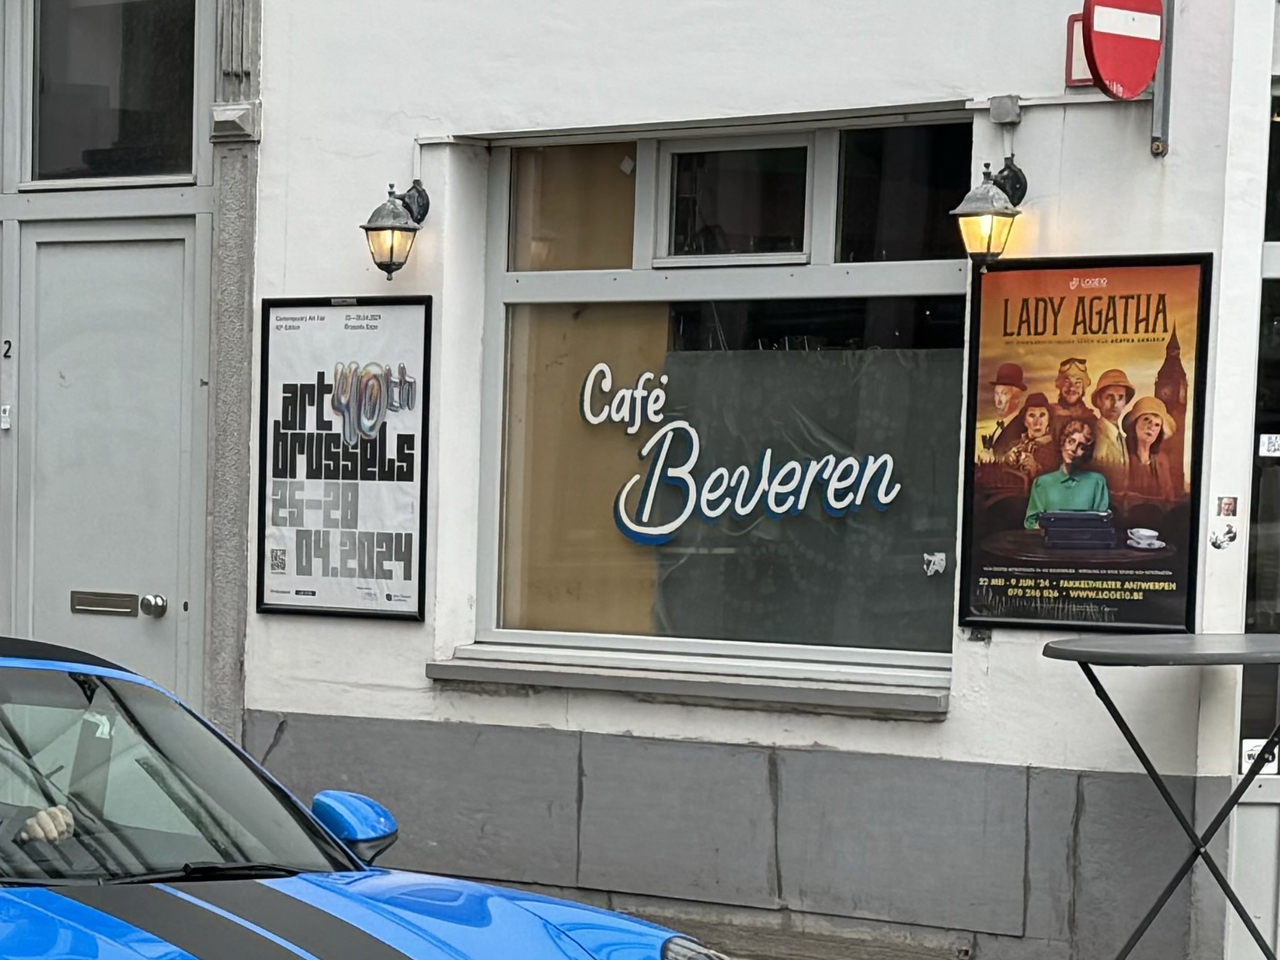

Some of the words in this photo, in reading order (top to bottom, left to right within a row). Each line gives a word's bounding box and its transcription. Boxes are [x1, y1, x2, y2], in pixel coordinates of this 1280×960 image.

[1003, 296, 1066, 337] LADY
[1072, 294, 1169, 335] AGATHA
[3, 340, 12, 359] 2
[281, 371, 334, 431] art
[582, 361, 669, 435] Café
[272, 420, 416, 482] brussels
[617, 419, 902, 537] Beveren
[296, 529, 413, 581] 04.2024
[1018, 578, 1035, 587] JUN
